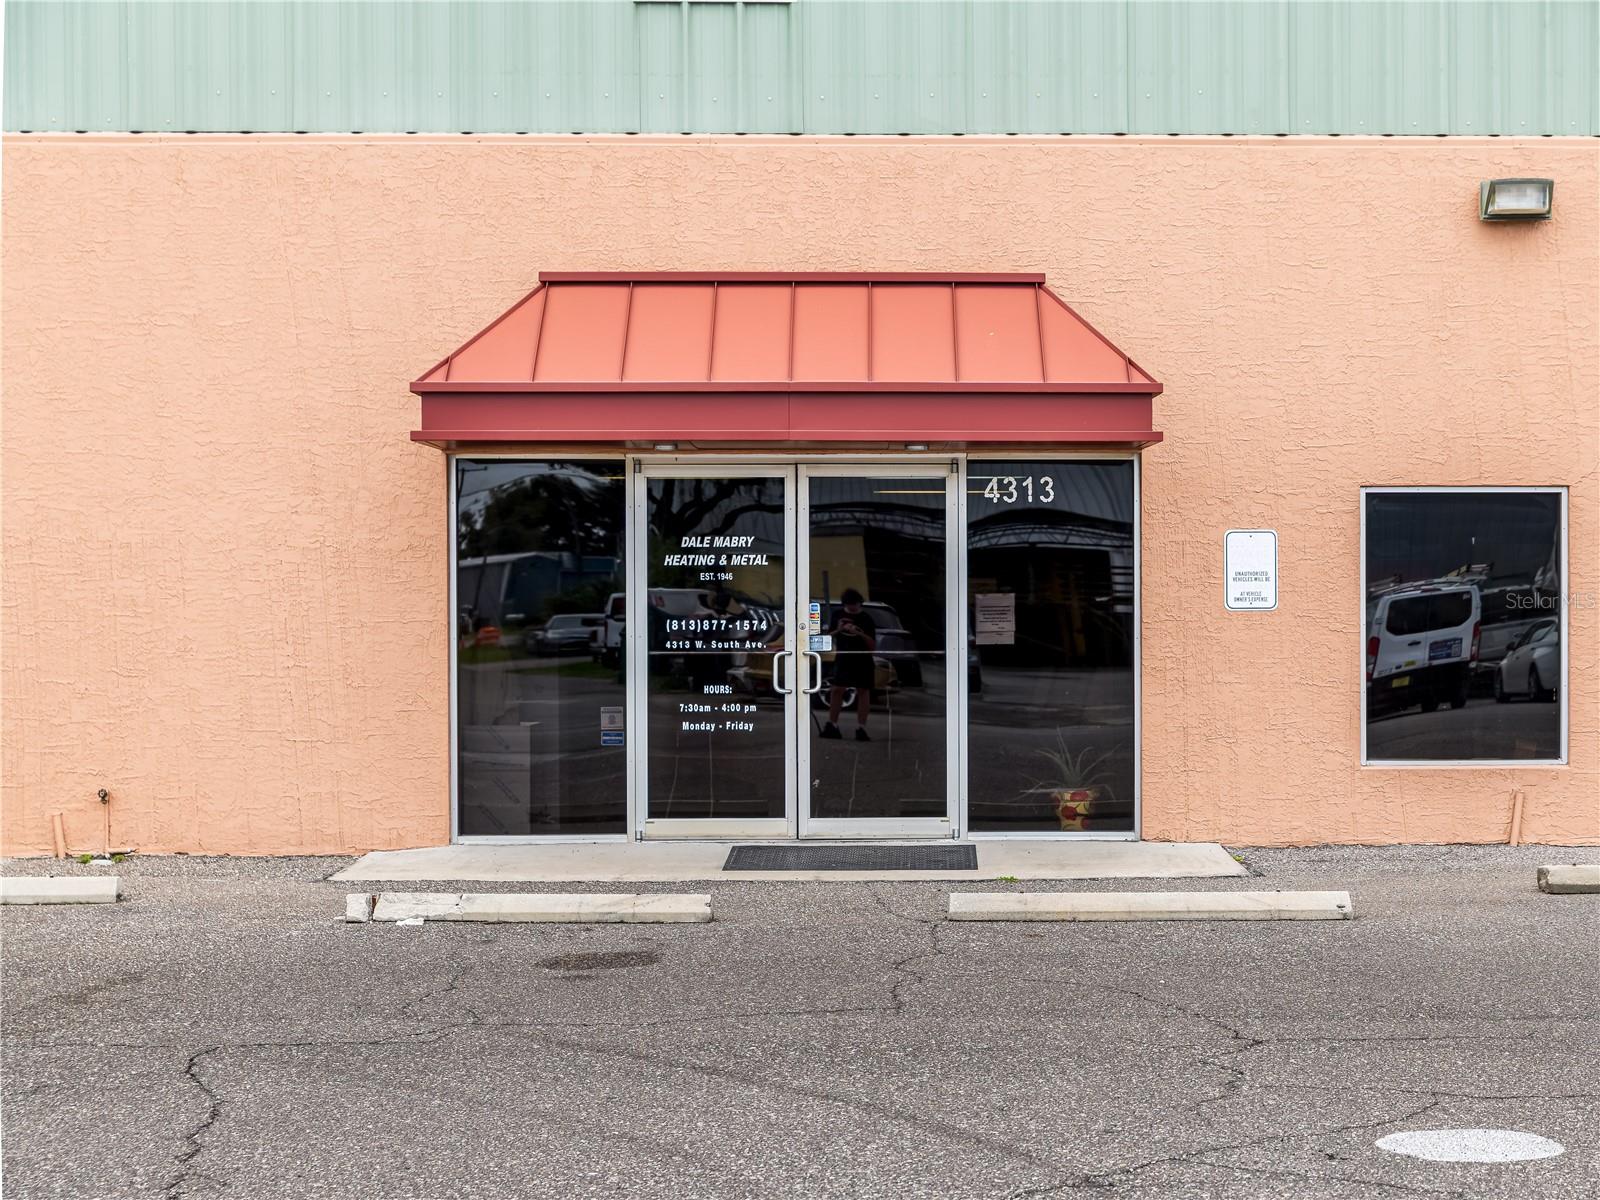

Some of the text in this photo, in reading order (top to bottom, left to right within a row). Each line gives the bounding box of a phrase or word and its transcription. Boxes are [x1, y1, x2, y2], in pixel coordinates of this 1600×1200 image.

[984, 476, 1055, 503] 4313
[681, 536, 755, 548] DALE MABRY
[664, 554, 769, 566] HEATING & METAL
[700, 572, 733, 581] EST. 1946
[666, 619, 768, 633] (813)877-1574
[665, 640, 767, 649] 4313 W. South Ave.
[703, 685, 733, 694] HOURS:
[679, 703, 711, 712] 7:30am
[721, 703, 741, 712] 4:00
[744, 705, 757, 714] pm
[682, 721, 716, 732] Monday
[726, 721, 754, 732] Friday
